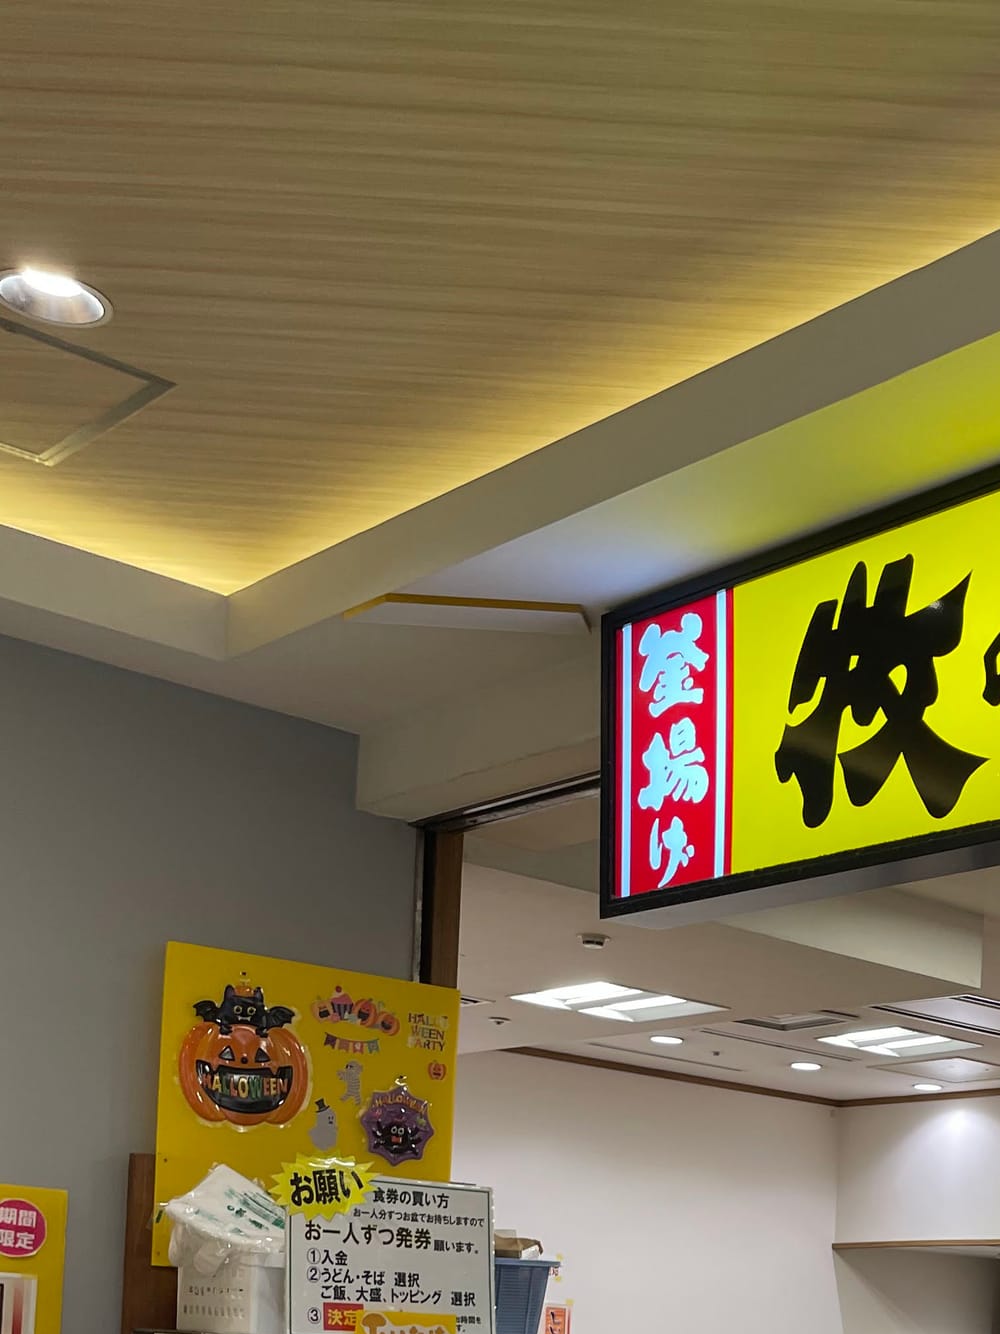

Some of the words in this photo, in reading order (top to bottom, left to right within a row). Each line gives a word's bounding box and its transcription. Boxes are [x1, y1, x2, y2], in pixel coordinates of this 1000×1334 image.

[637, 612, 711, 889] 釜揚げ
[200, 1073, 290, 1099] HALLOWEEN
[289, 1168, 364, 1207] お願い
[372, 1187, 450, 1209] 食券の買い方
[304, 1219, 432, 1250] お一人ずつ発券
[394, 1271, 420, 1289] 選択
[320, 1284, 442, 1305] ご飯、大盛、トッピング
[450, 1290, 476, 1308] 選択
